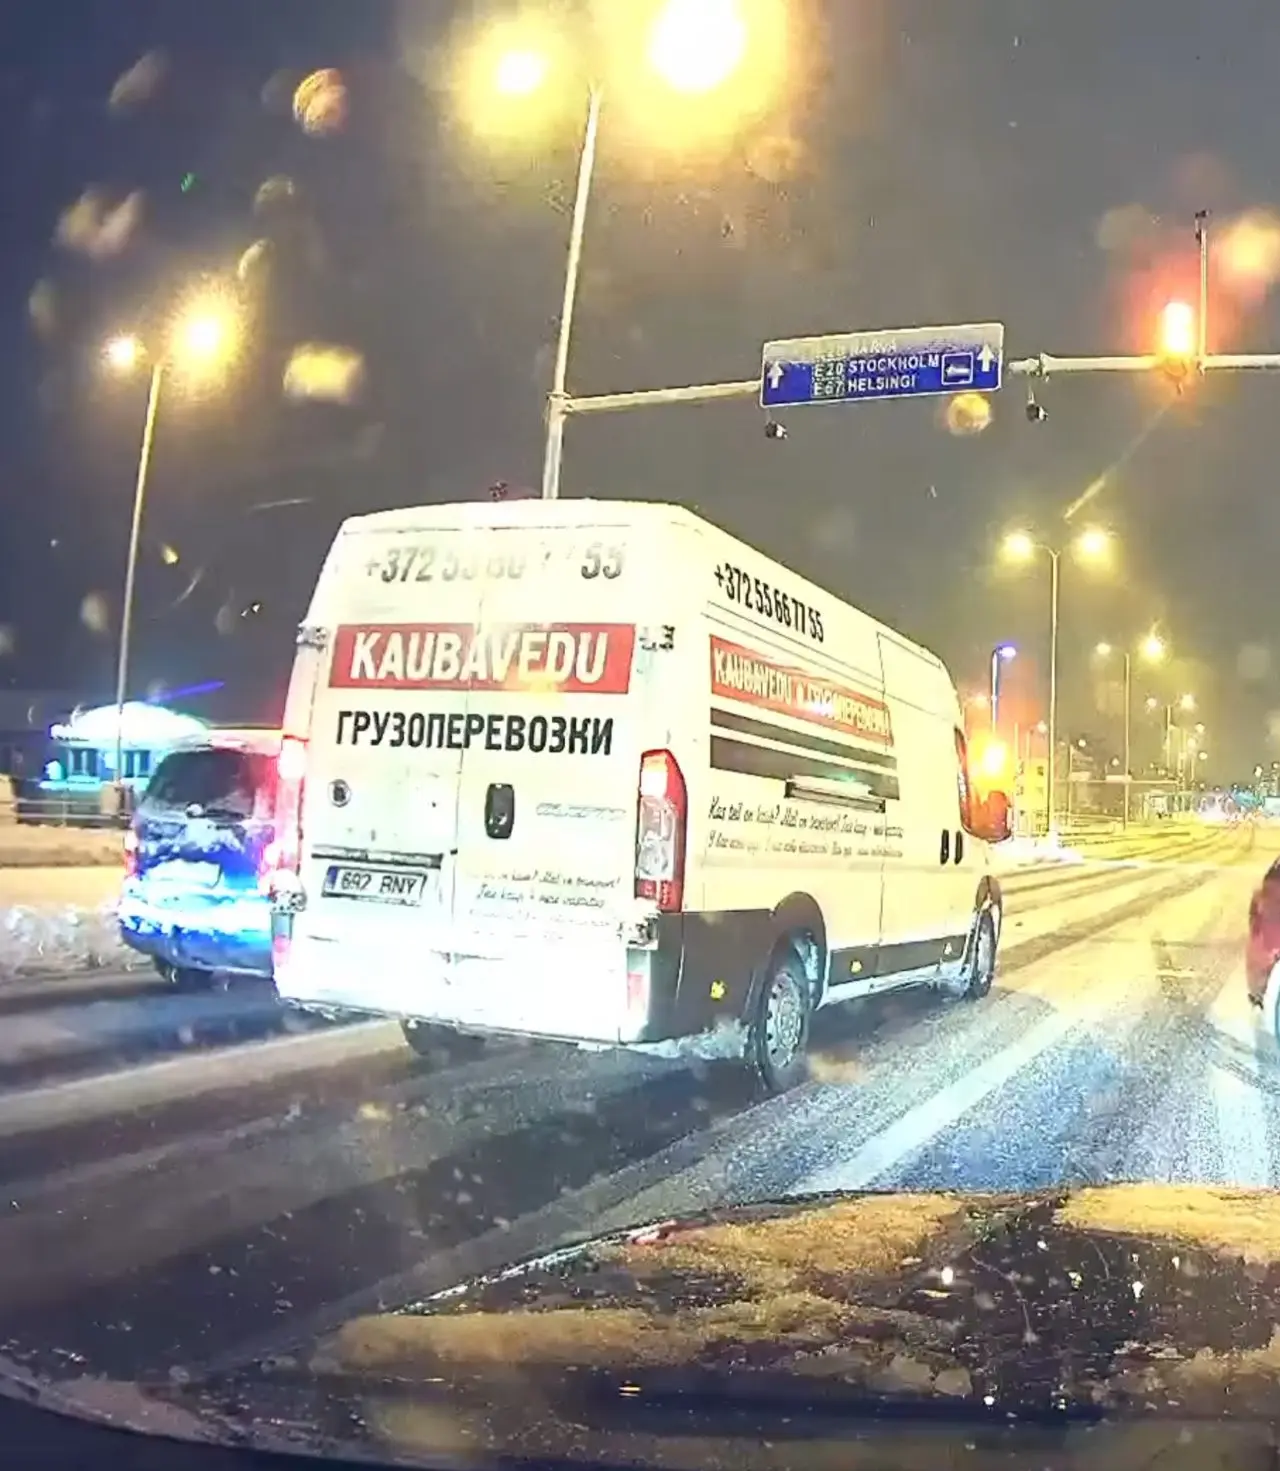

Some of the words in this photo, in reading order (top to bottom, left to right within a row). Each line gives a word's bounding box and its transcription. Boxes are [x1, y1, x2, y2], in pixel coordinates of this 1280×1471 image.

[848, 354, 940, 374] STOCKHOLM
[848, 374, 916, 392] HELSINGI
[714, 563, 753, 609] +372
[754, 577, 773, 618] 55
[774, 588, 791, 627] 66
[790, 597, 806, 635] 77
[807, 606, 824, 643] 55
[350, 631, 608, 684] KAUBAVEDU
[335, 710, 614, 756] ГРУЗОПЕРЕВОЗКИ
[341, 871, 372, 891] 692
